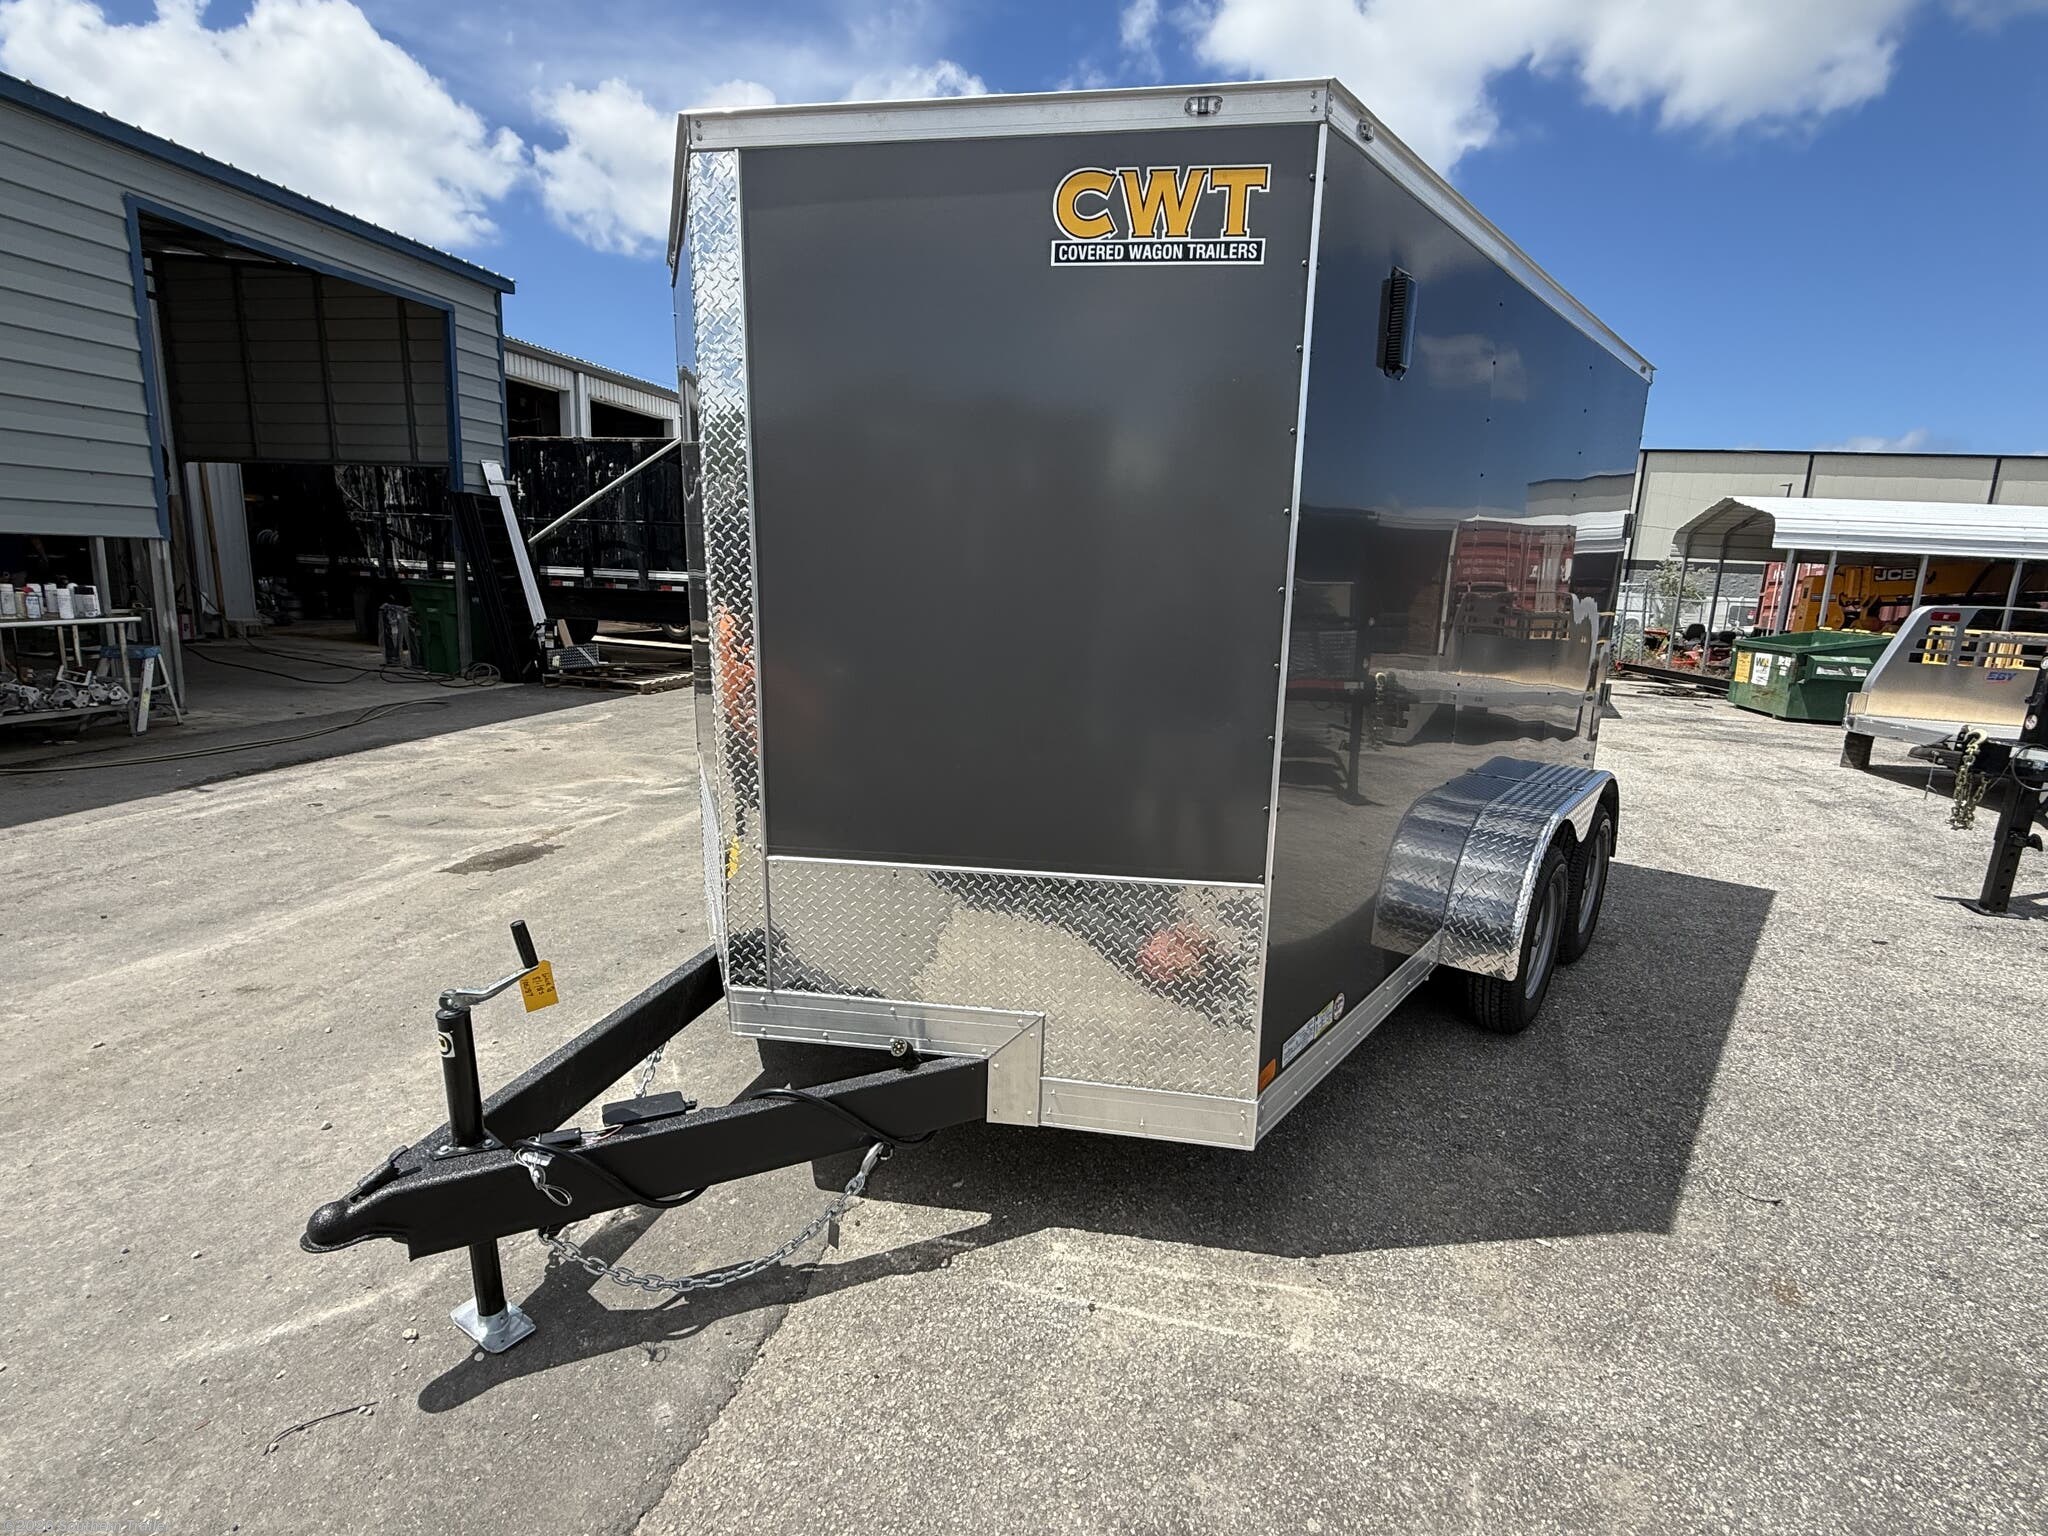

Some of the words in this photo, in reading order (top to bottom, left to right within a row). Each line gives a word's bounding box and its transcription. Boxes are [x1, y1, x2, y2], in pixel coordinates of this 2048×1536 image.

[1054, 165, 1270, 239] CWT
[1059, 244, 1124, 261] COVERED
[1129, 243, 1182, 260] WAGON
[1187, 243, 1258, 260] TRAILERS
[1875, 569, 1917, 580] JCB
